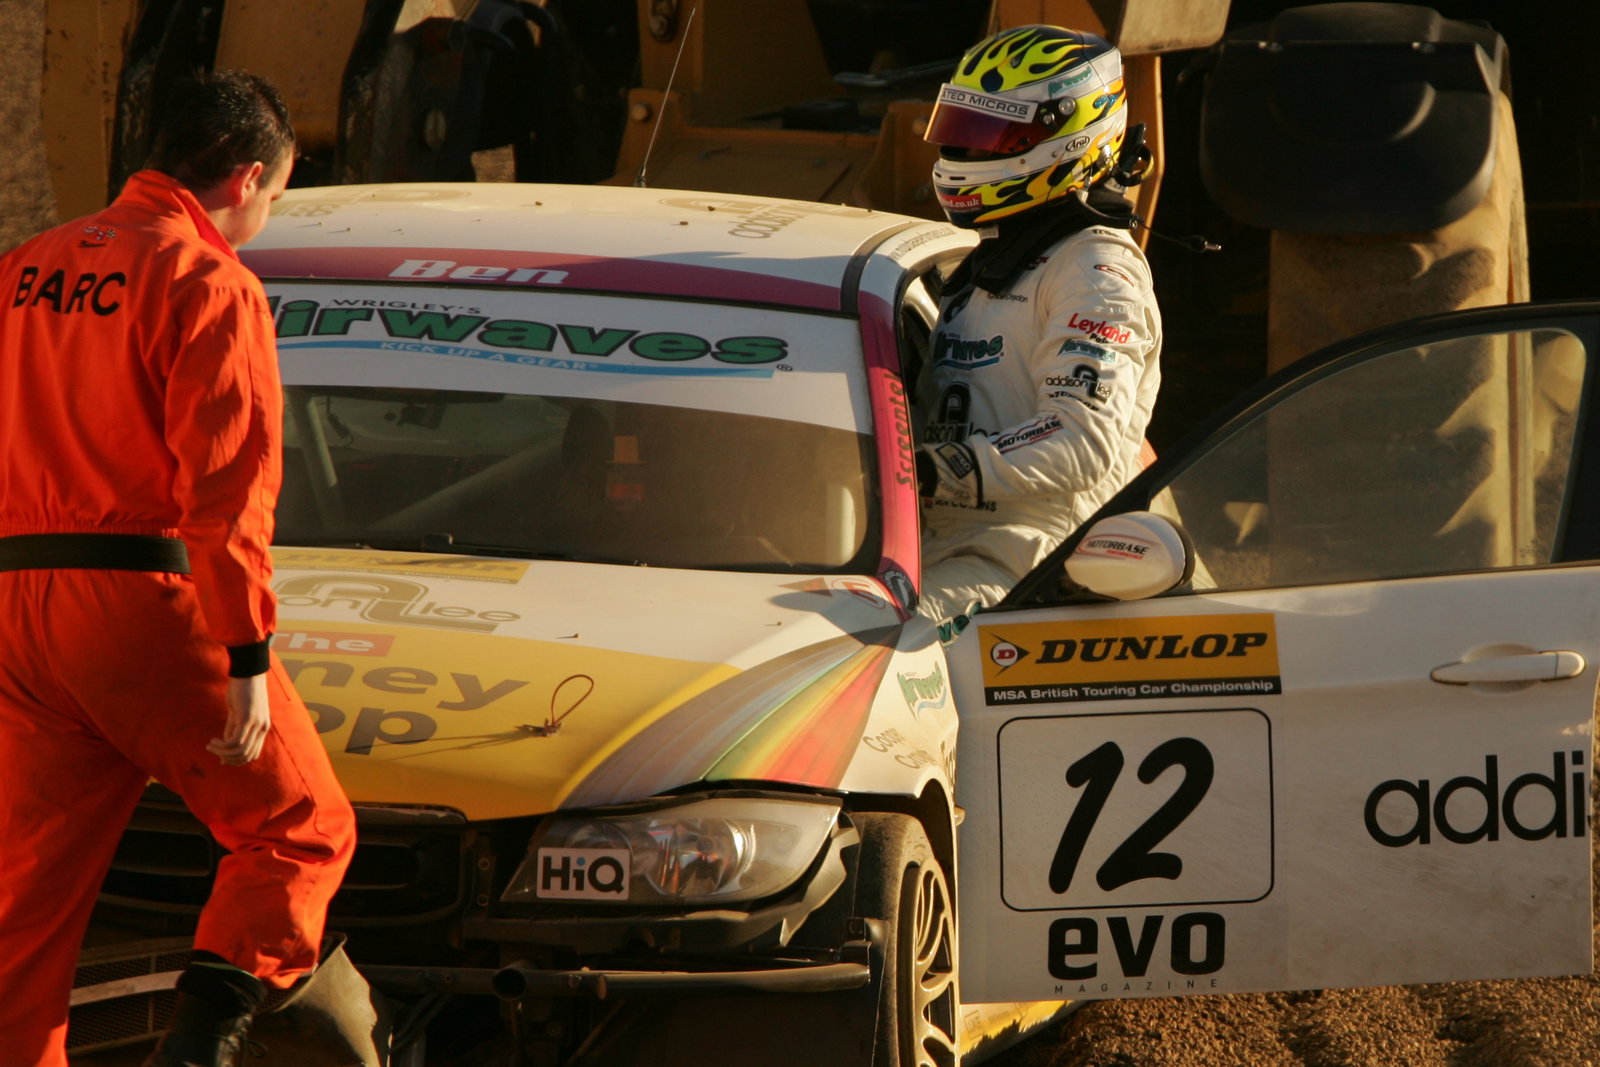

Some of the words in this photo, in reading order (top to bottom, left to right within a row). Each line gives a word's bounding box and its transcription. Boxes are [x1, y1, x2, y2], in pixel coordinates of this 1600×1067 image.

[969, 95, 1029, 115] MICROS
[388, 259, 569, 284] Ben
[12, 266, 127, 316] BARC
[332, 299, 481, 314] WRIGLEY'S
[1067, 312, 1131, 344] Leyland
[380, 341, 440, 354] KICK
[447, 348, 481, 358] UP
[487, 351, 506, 362] A
[1045, 375, 1089, 388] addison
[1087, 539, 1151, 556] MOTORBASE
[420, 601, 522, 622] lee
[1035, 632, 1268, 664] DUNLOP
[993, 689, 1028, 701] MSA
[1030, 687, 1079, 699] British
[1082, 684, 1137, 700] Touring
[1140, 683, 1167, 696] Car
[1170, 680, 1274, 695] Championship
[1364, 750, 1593, 848] addi
[1049, 737, 1214, 894] 12
[541, 856, 625, 894] HiQ
[1048, 912, 1226, 980] evo
[1054, 978, 1218, 995] MAGAZINE
